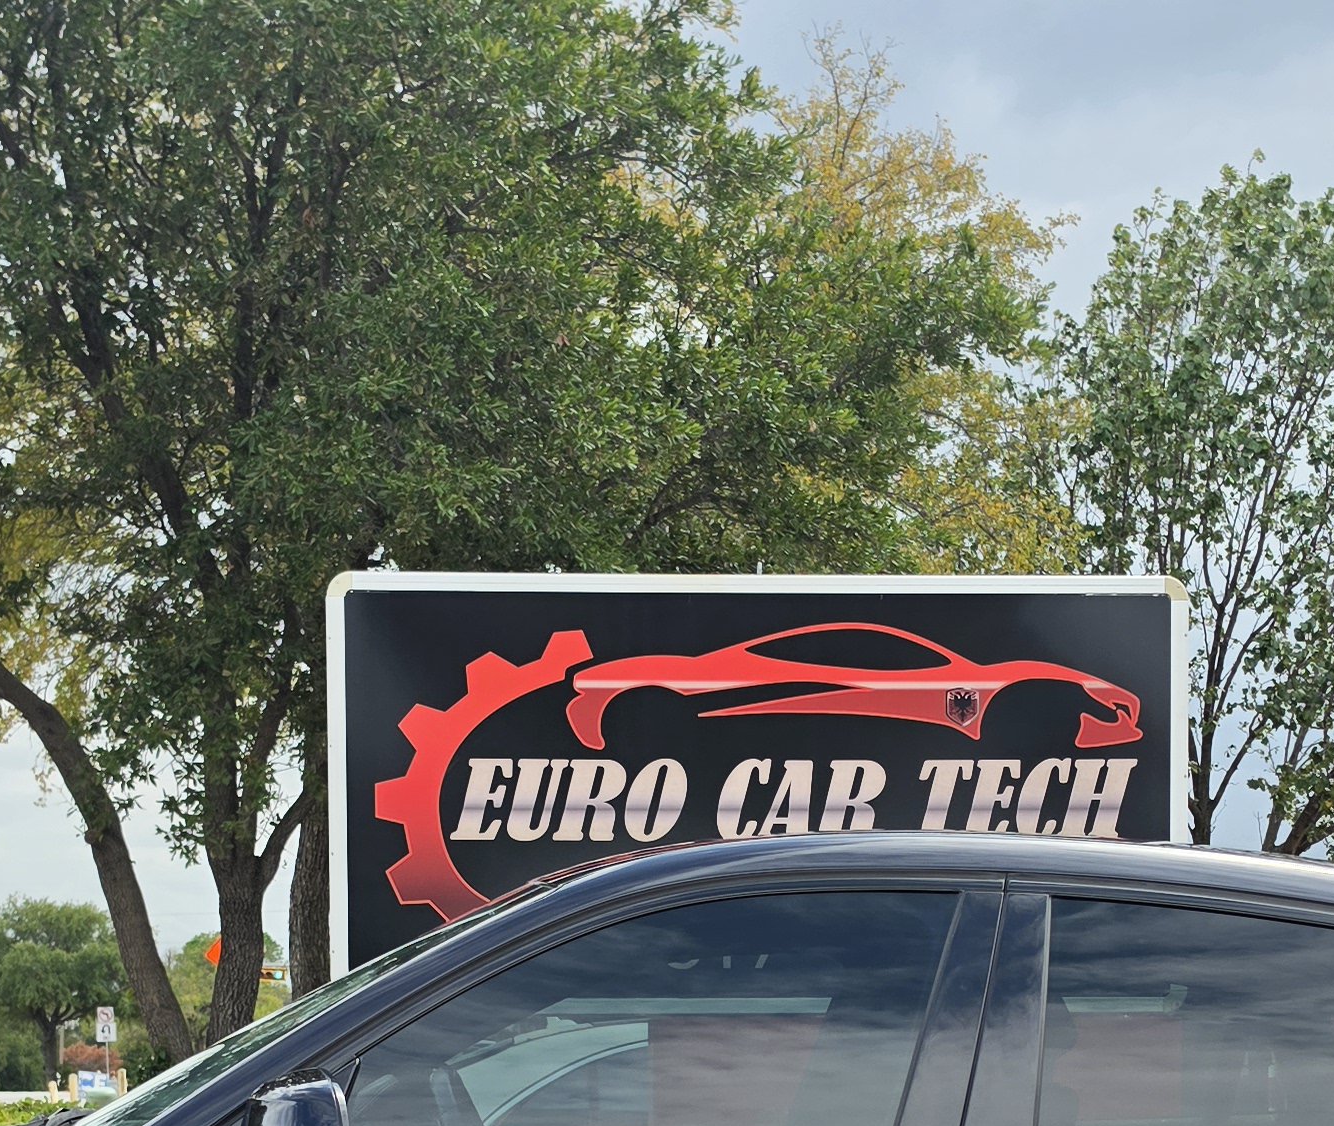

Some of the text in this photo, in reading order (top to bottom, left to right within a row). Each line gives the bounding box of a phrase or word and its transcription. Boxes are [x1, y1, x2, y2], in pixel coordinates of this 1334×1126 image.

[449, 757, 1139, 842] EURO CAR TECH
